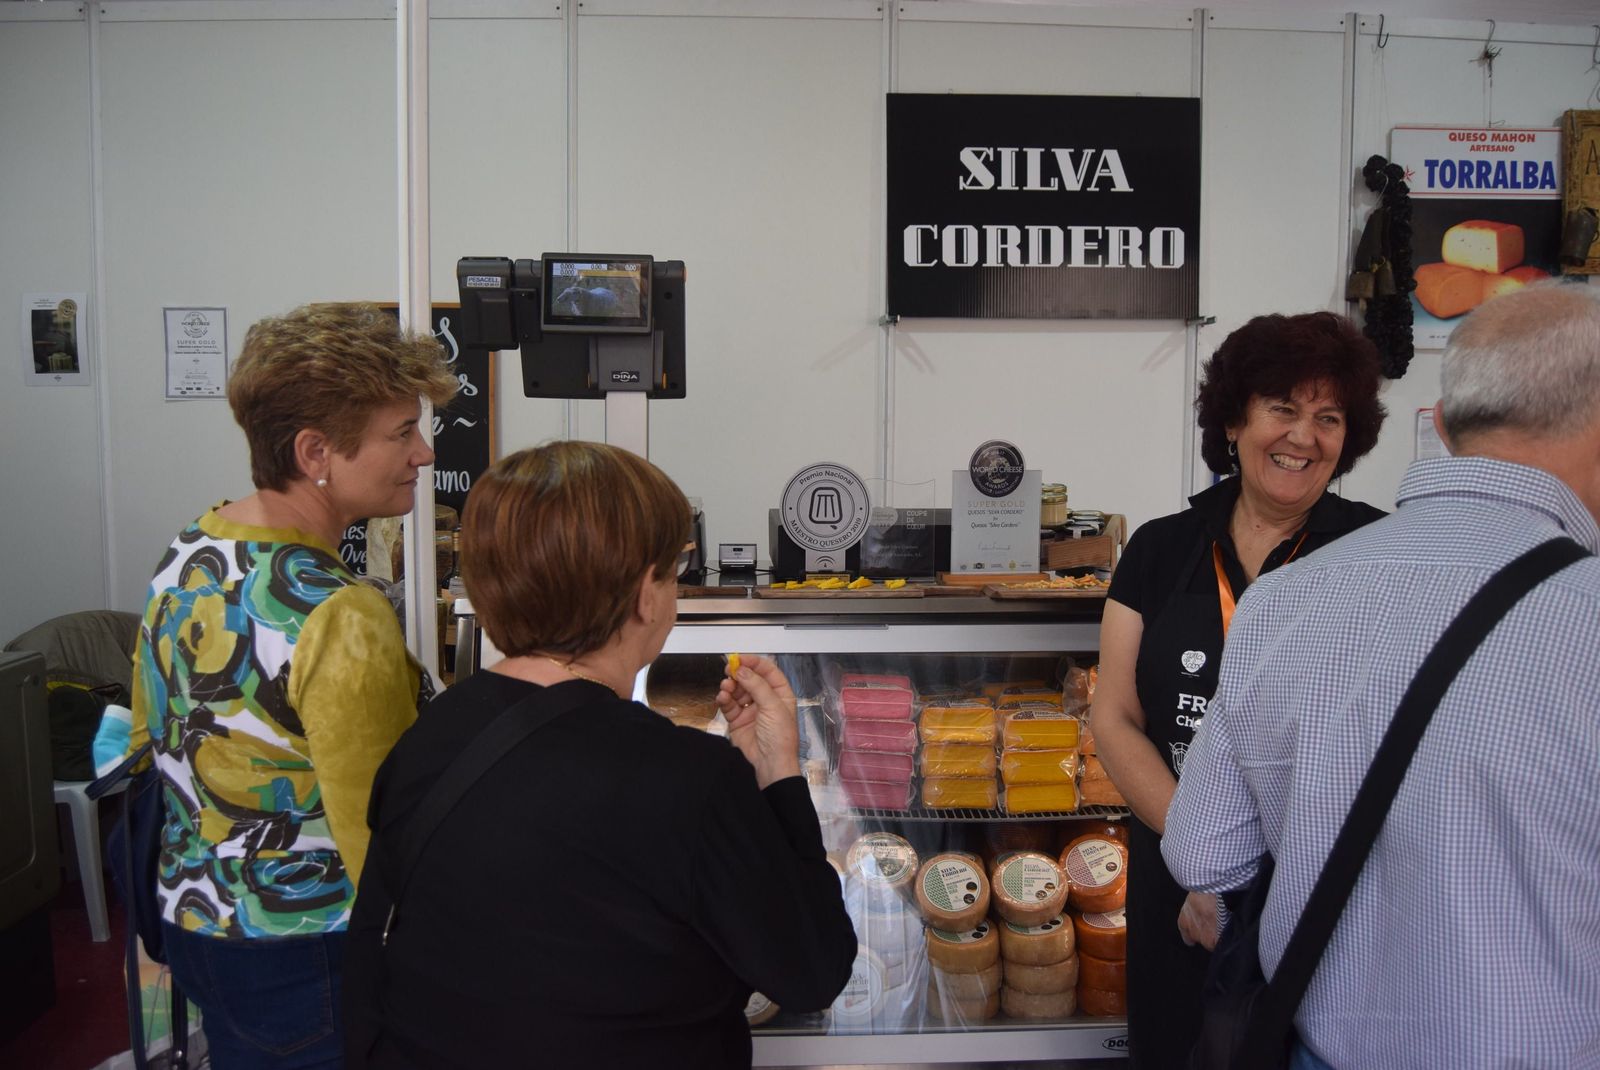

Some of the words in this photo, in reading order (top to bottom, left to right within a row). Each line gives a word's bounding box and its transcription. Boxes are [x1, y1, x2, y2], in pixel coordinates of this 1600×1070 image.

[1448, 132, 1487, 142] QUESO
[1490, 133, 1536, 143] MAHON
[959, 147, 1134, 192] SILVA
[1424, 159, 1557, 189] TORRALBA
[903, 224, 1185, 269] CORDERO
[612, 373, 638, 381] DINA
[799, 470, 824, 485] Premio
[824, 470, 854, 486] Nacional
[999, 465, 1023, 473] CHEESE
[967, 500, 997, 508] SUPER
[999, 500, 1025, 508] GOLD
[790, 519, 819, 545] MAESTRO
[819, 531, 852, 548] QUESERO
[340, 543, 368, 565] Ove
[1176, 693, 1209, 713] FR
